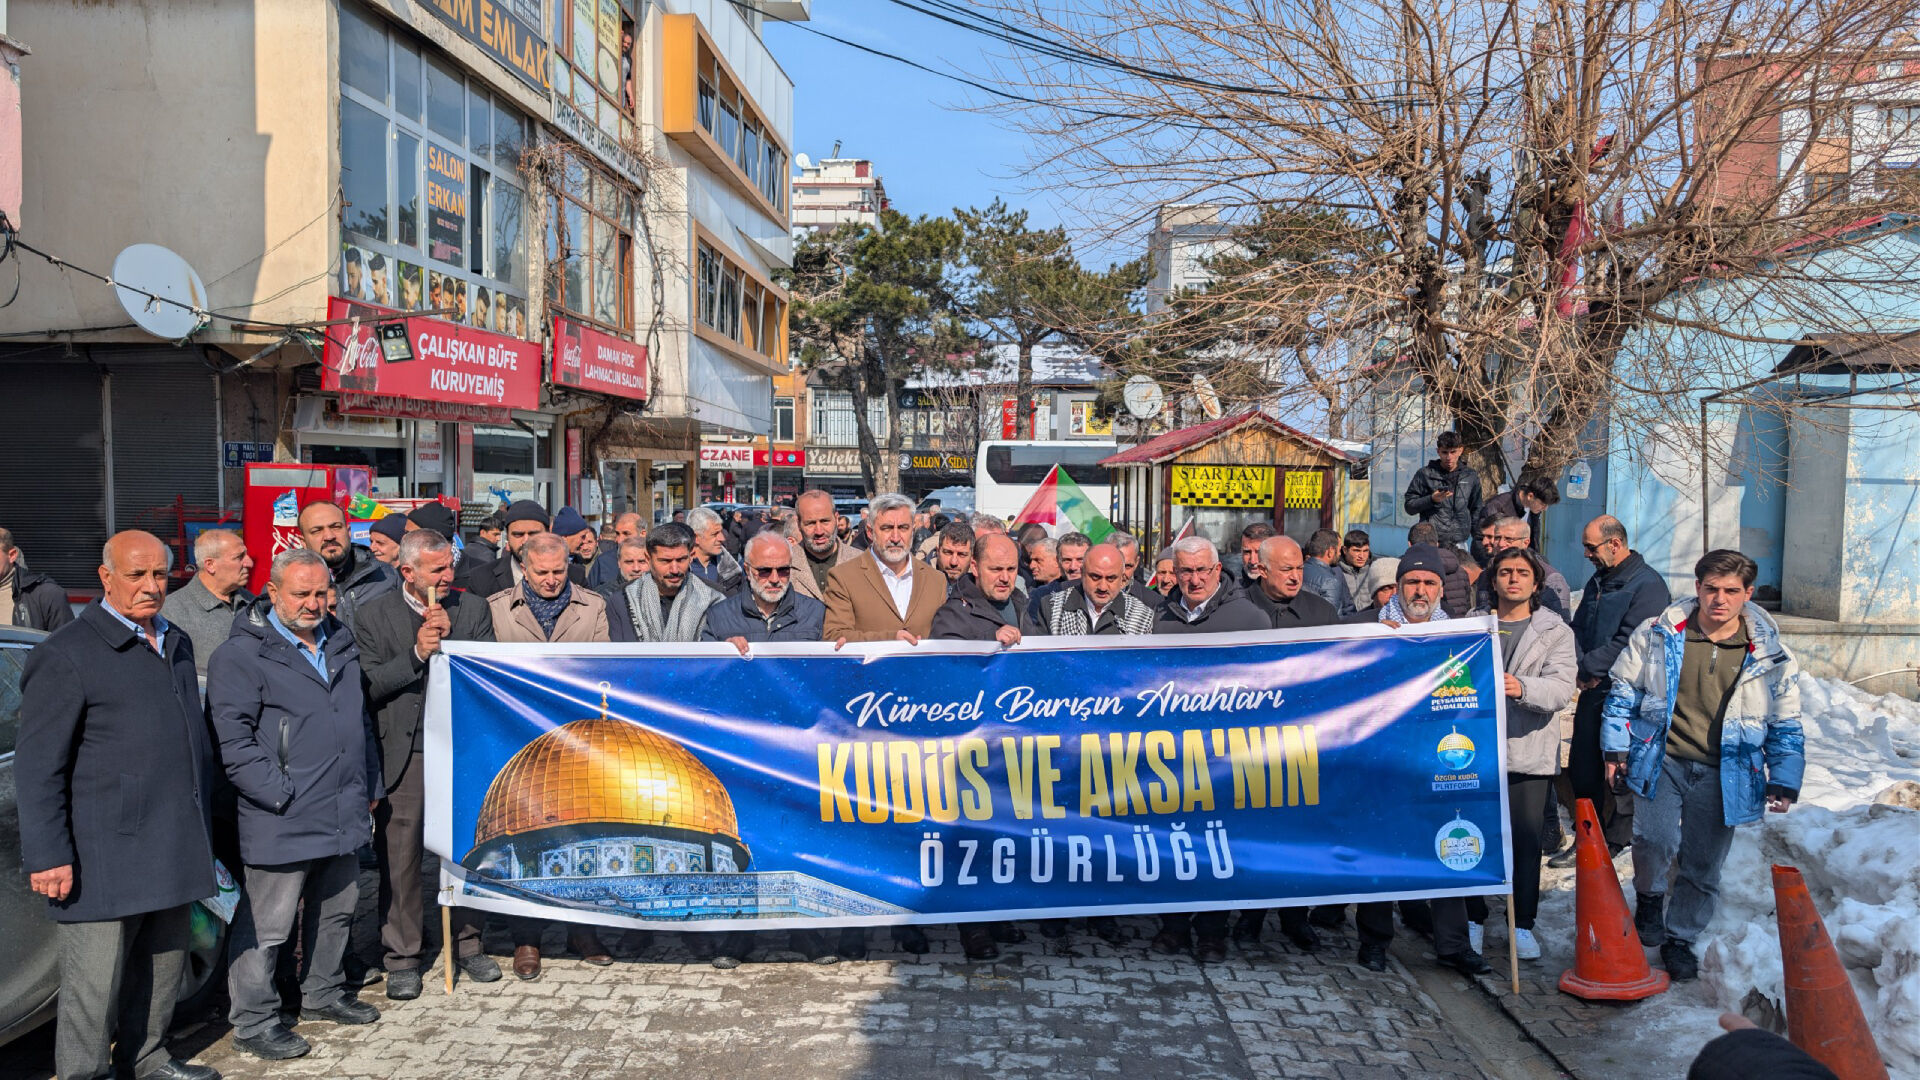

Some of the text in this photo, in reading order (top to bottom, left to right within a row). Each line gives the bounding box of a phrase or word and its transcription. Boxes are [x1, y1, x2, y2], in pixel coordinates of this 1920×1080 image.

[481, 0, 550, 89] EMLAK
[429, 146, 465, 184] SALON
[428, 181, 465, 218] ERKAN
[418, 332, 518, 371] ÇALIŞKAN BÜFE
[597, 344, 635, 368] DAMAK PİDE
[430, 368, 505, 402] KURUYEMİŞ
[584, 362, 645, 390] LAHMACUN SALONU
[699, 448, 751, 461] CZANE
[912, 456, 940, 469] SALON
[1181, 467, 1265, 481] STAR TAXI
[1202, 482, 1253, 491] 827 52 18
[1286, 474, 1321, 486] STAR TAXI
[845, 680, 1285, 727] Küresel Barışın Anahtarı
[1431, 696, 1478, 706] PEYGAMBER
[817, 724, 1320, 824] KUDÜS VE AKSA'NIN
[1434, 773, 1457, 781] ÖZGÜR
[1435, 781, 1478, 790] PLATFORMU
[919, 820, 1235, 888] ÖZGÜRLÜĞÜ
